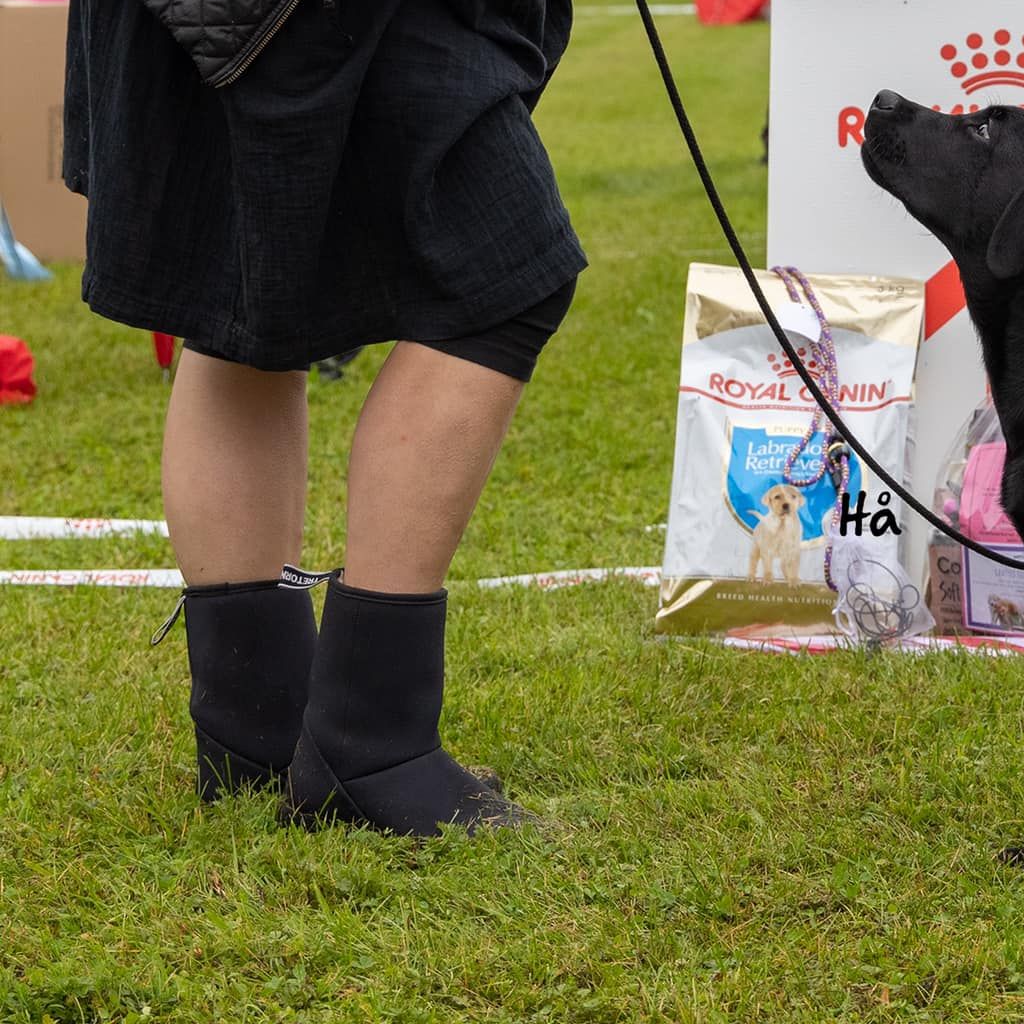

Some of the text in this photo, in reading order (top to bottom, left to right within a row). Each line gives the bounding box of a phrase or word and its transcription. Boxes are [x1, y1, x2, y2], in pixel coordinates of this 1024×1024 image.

[709, 373, 887, 403] ROYAL CNIN
[747, 439, 823, 456] Labrao
[745, 456, 823, 472] Retrve
[716, 592, 744, 600] BREED
[748, 594, 783, 602] HEALTH
